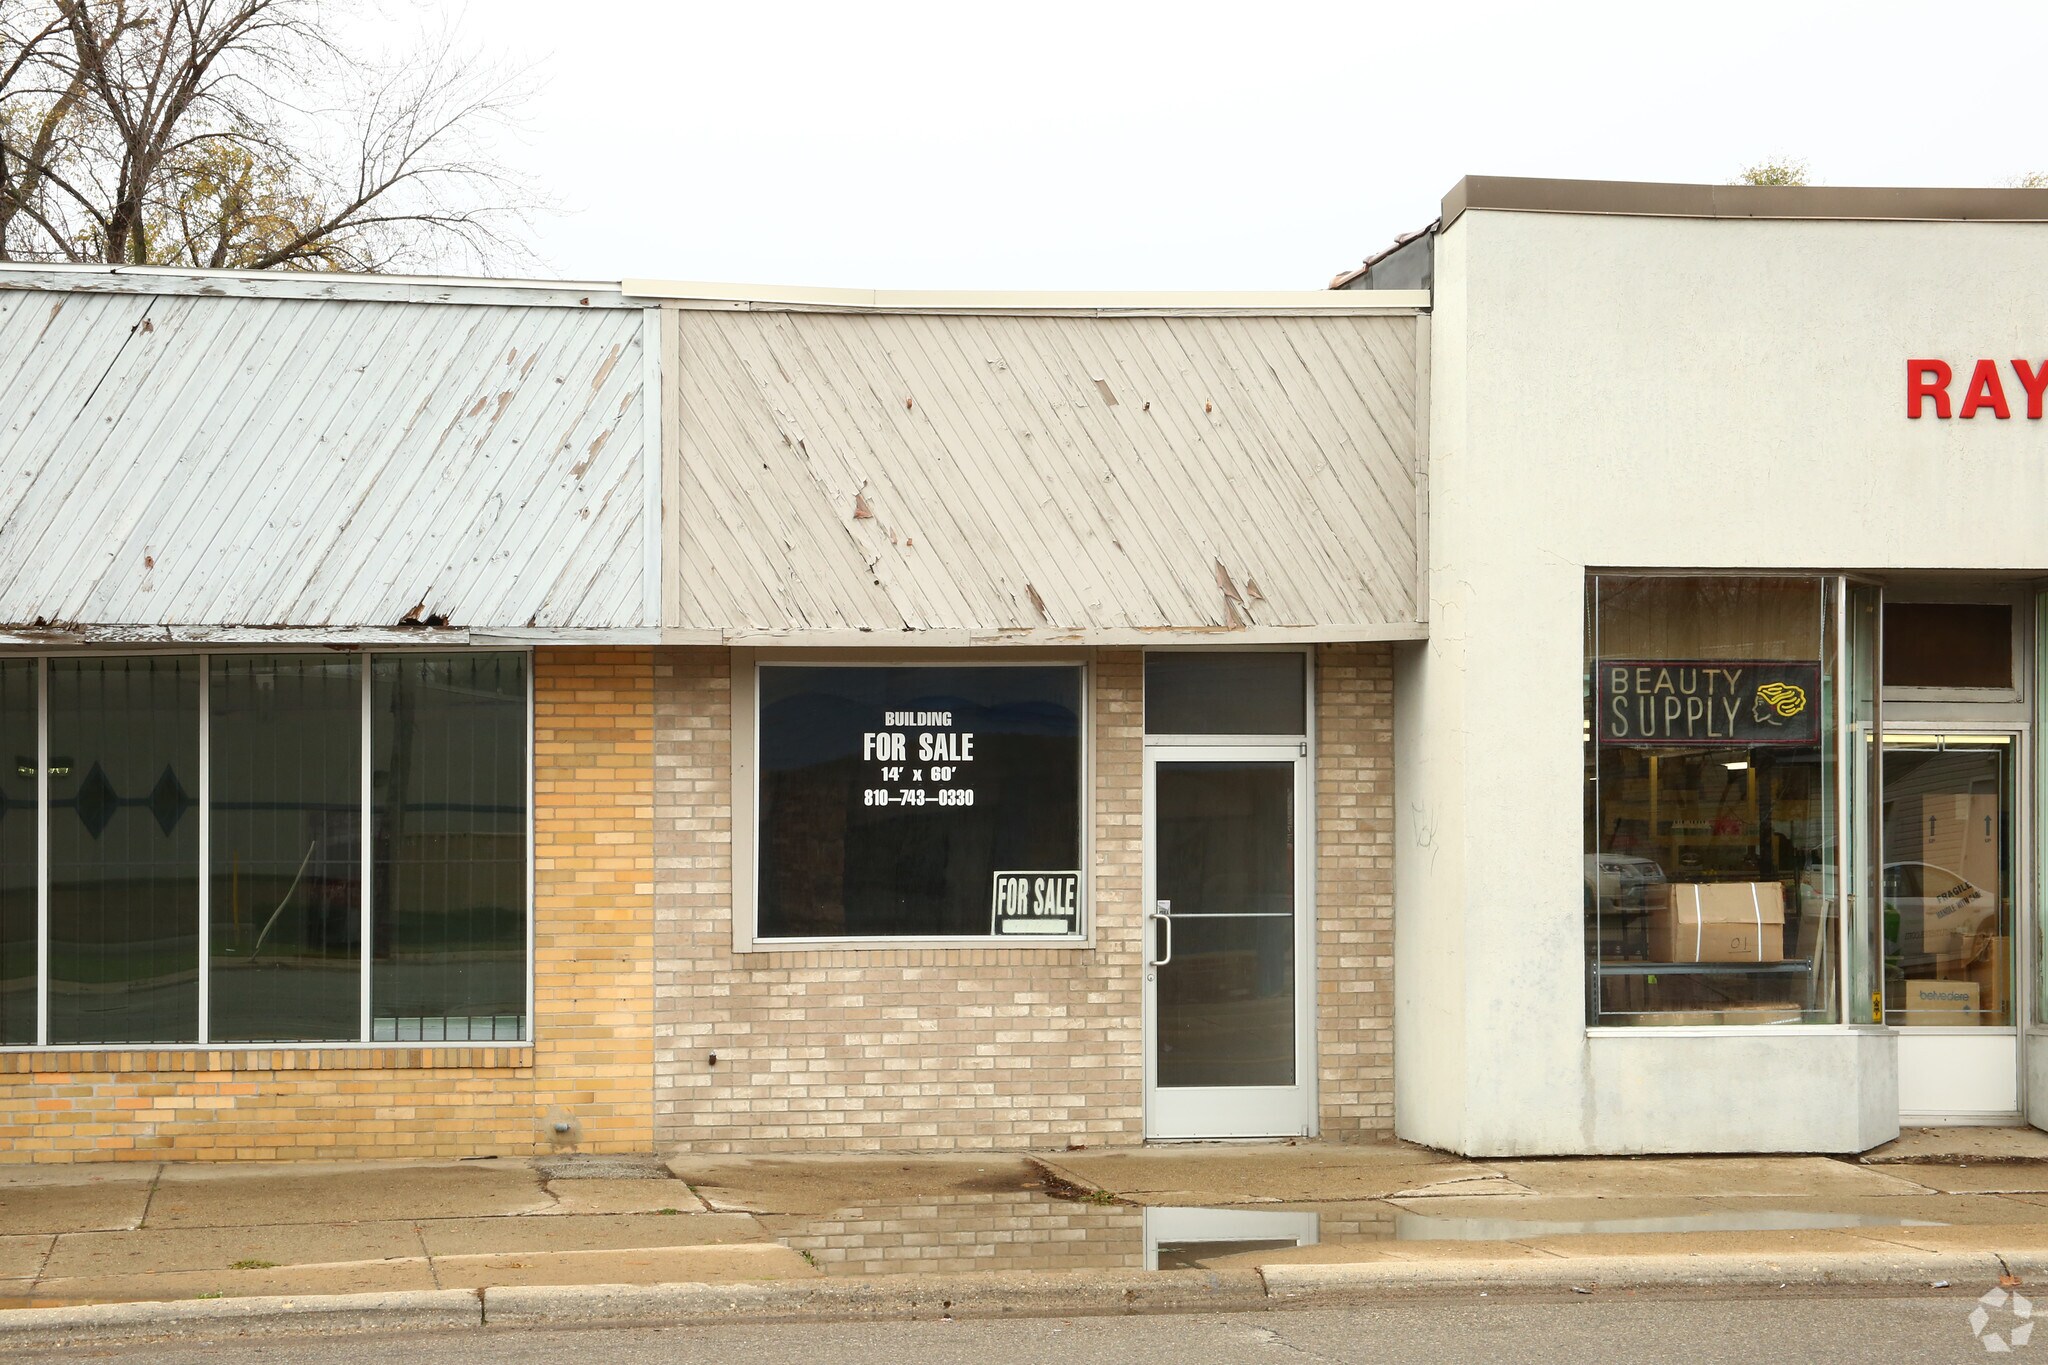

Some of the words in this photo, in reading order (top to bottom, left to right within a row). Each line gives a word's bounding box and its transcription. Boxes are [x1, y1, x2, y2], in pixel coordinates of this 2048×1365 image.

[1907, 359, 2048, 419] RAY
[1611, 667, 1742, 695] BEAUTY
[885, 711, 952, 727] BUILDING
[1611, 696, 1741, 738] SUPPLY
[863, 732, 907, 761] FOR
[918, 732, 974, 761] SALE
[881, 766, 904, 782] 14'
[912, 769, 922, 782] x
[930, 766, 957, 782] 60'
[864, 789, 974, 806] 810-743-0330
[997, 877, 1028, 915] FOR
[1033, 877, 1075, 915] SALE
[1936, 881, 1973, 903] FRAGILE
[1919, 990, 1970, 1001] belvedere
